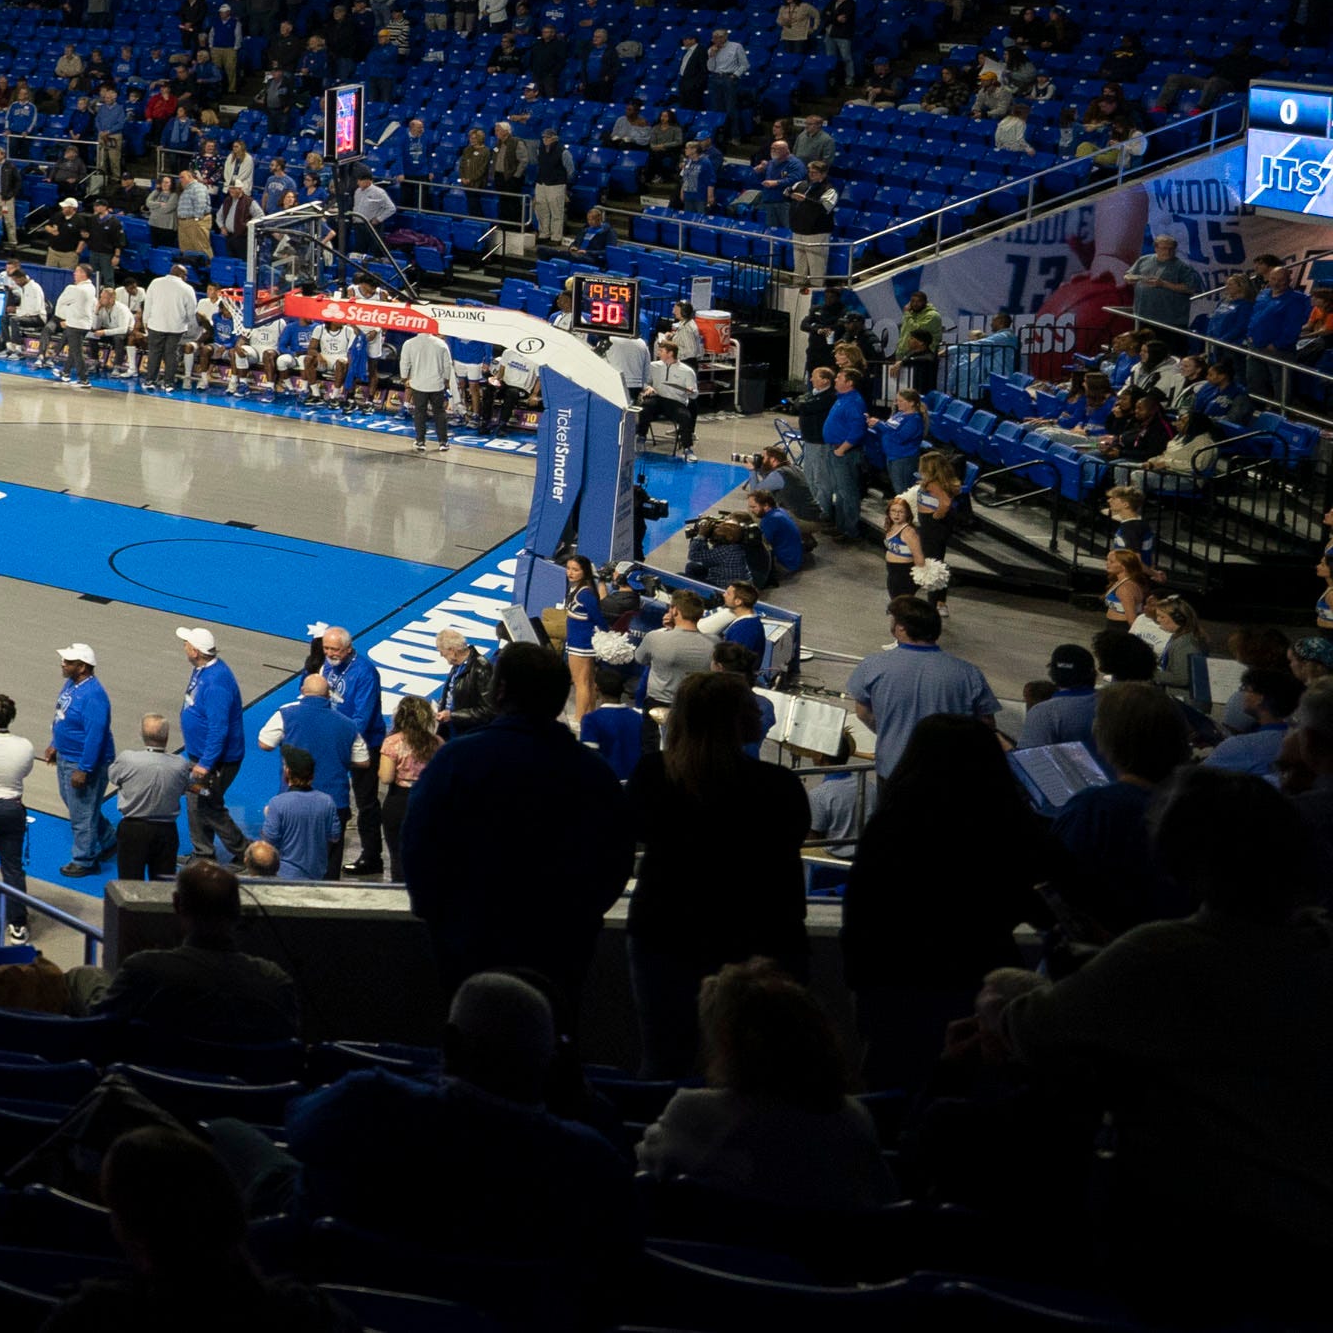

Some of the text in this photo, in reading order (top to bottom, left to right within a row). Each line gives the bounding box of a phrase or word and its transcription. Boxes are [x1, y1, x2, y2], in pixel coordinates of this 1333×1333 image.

[1279, 98, 1298, 125] 0
[1171, 214, 1247, 266] 15
[589, 284, 631, 303] 19:59
[1000, 254, 1068, 316] 13
[431, 307, 486, 323] SPALDING
[591, 301, 622, 325] 30
[260, 332, 270, 341] 31
[329, 342, 339, 352] 15
[523, 412, 537, 423] $10
[552, 408, 572, 505] TicketSmarter
